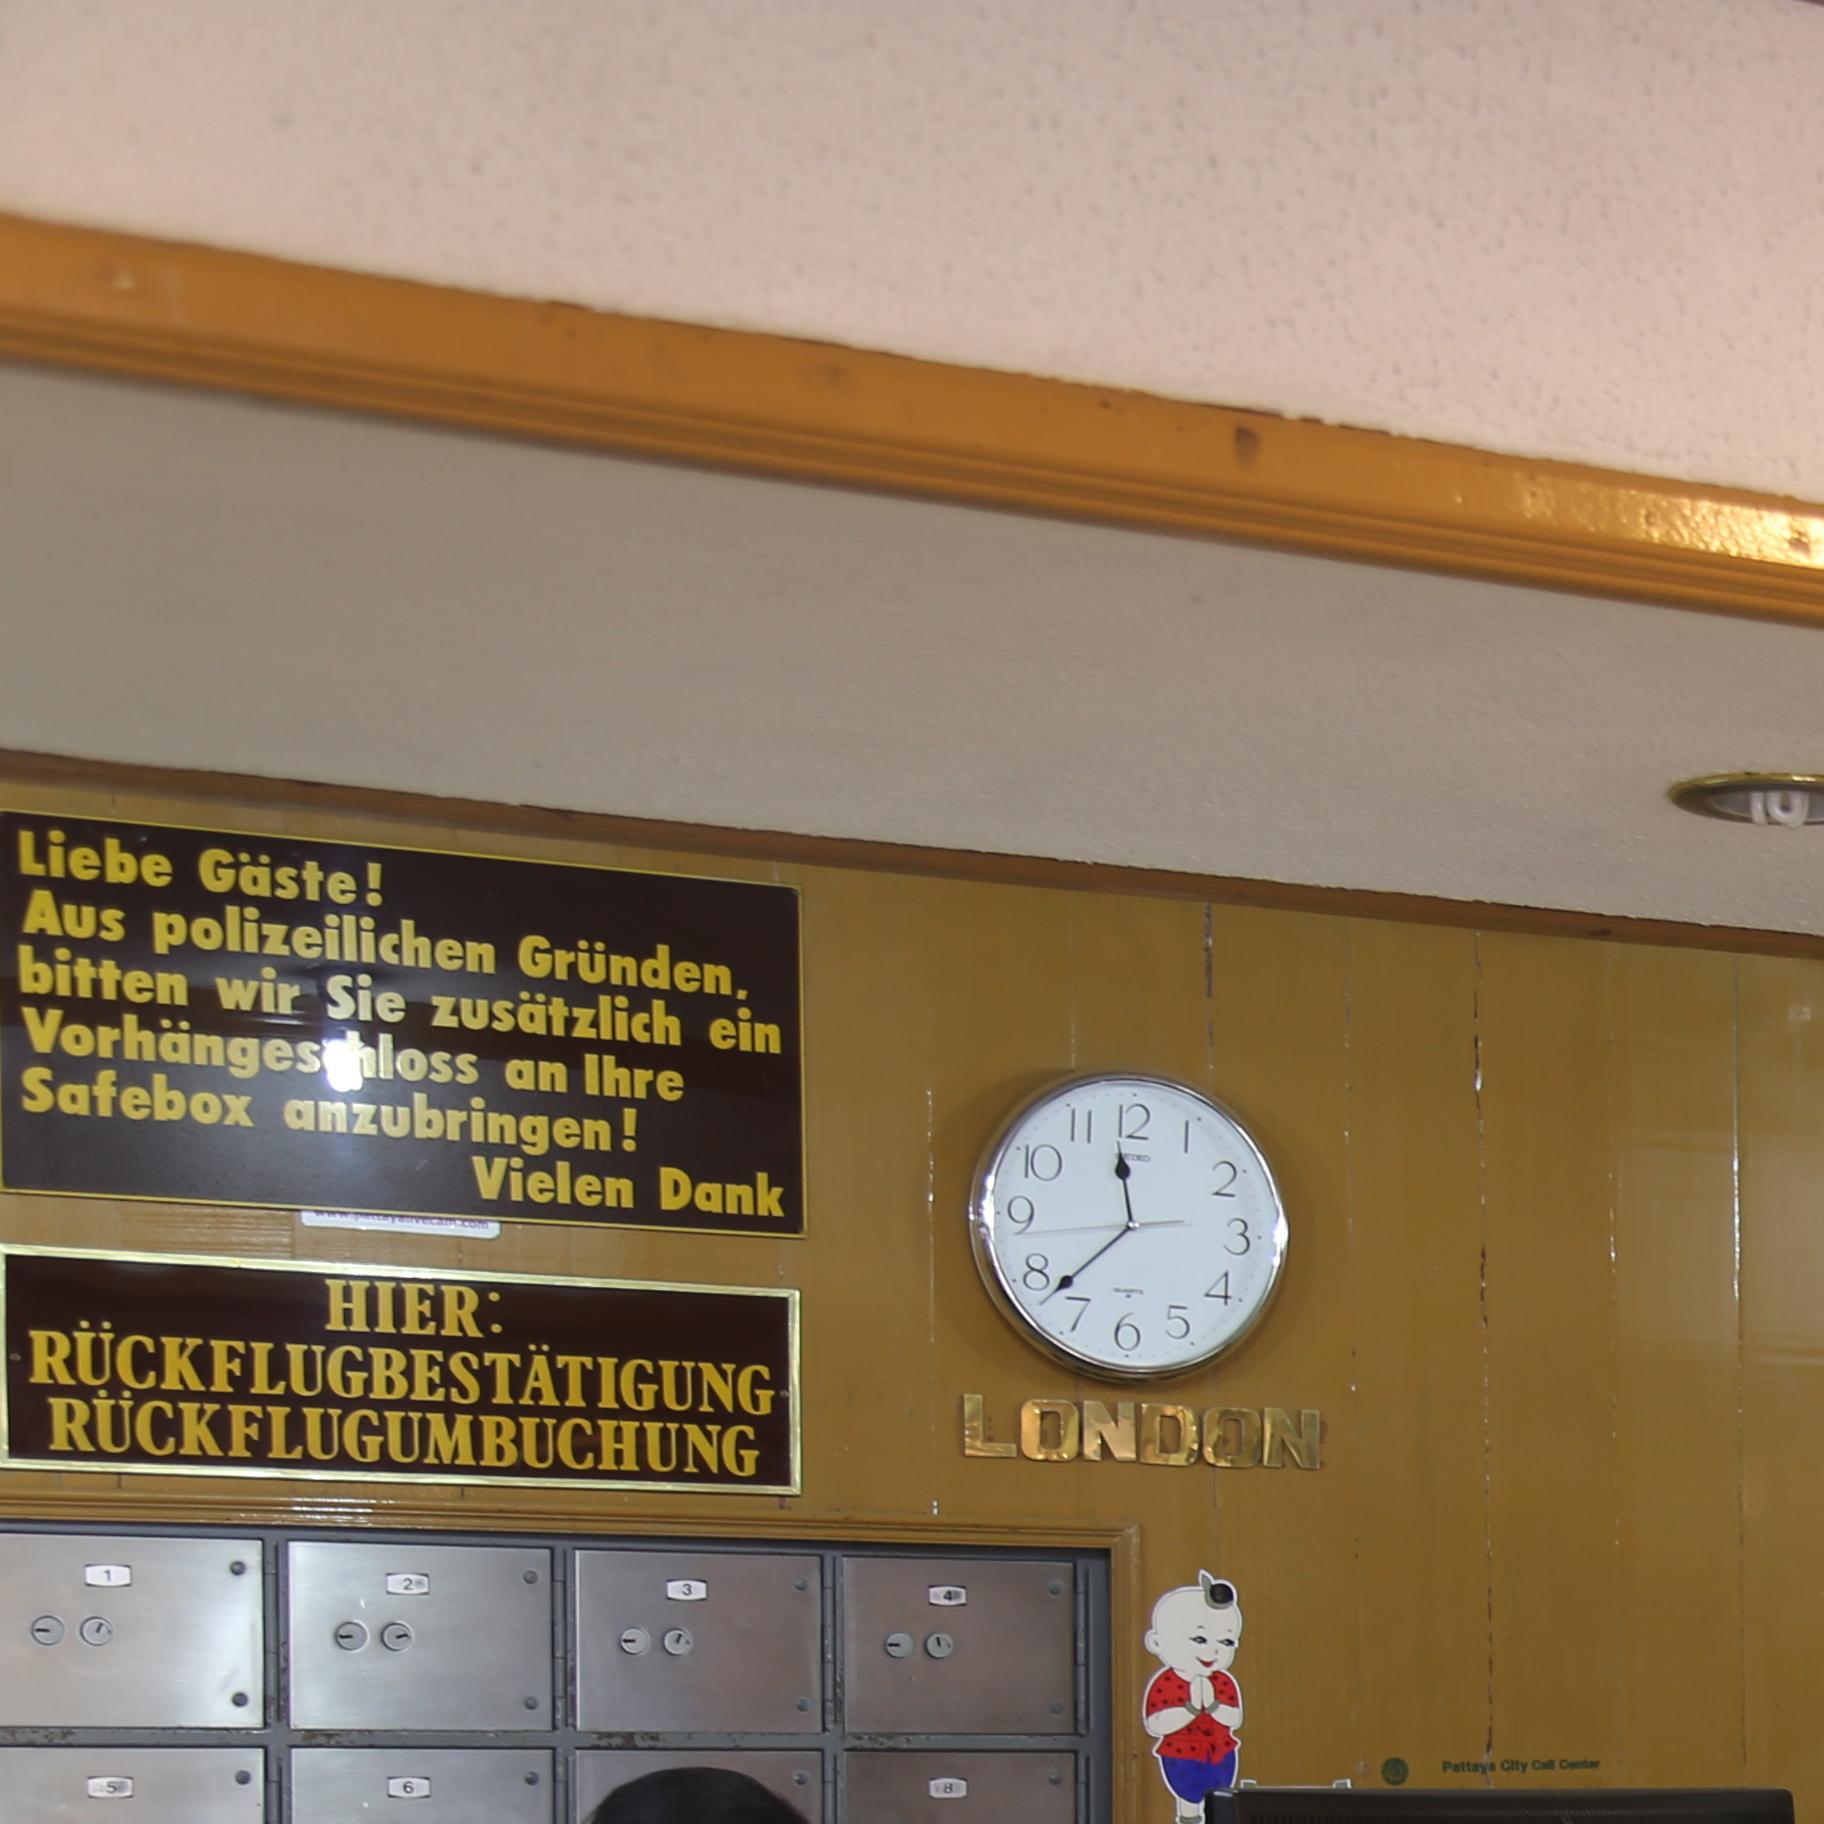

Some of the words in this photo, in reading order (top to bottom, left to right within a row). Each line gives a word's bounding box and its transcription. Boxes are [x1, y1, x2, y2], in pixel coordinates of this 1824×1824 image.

[18, 829, 173, 888] Liebe
[200, 848, 384, 907] Gäste!
[23, 890, 125, 940] Aus
[153, 907, 496, 974] polizeilichen
[518, 936, 750, 997] Gründen,
[19, 946, 188, 1005] bitten
[215, 967, 301, 1015] wir
[326, 975, 406, 1023] Sie
[430, 992, 682, 1046] zusätzlich
[709, 1011, 782, 1054] ein
[21, 1006, 480, 1085] Vorhängeshloss
[506, 1050, 567, 1094] an
[585, 1053, 684, 1101] Ihre
[21, 1067, 253, 1127] Safebox
[285, 1093, 638, 1155] anzubringen!
[1071, 1108, 1092, 1143] 11
[1119, 1104, 1151, 1140] 12
[1024, 1144, 1062, 1181] 10
[1211, 1161, 1237, 1197] 2
[473, 1155, 633, 1208] Vielen
[660, 1168, 785, 1217] Dank
[1007, 1196, 1035, 1234] 9
[1223, 1217, 1250, 1256] 3
[1023, 1253, 1050, 1291] 8
[1204, 1270, 1232, 1305] 4
[326, 1279, 503, 1337] HIER:
[1065, 1296, 1091, 1333] 7
[1165, 1305, 1190, 1339] 5
[1114, 1313, 1141, 1351] 6
[29, 1319, 775, 1416] RÜCKFLUGBESTÄTIGUNG
[49, 1388, 759, 1478] RÜCKFLUGUMBUCHUNG
[964, 1393, 1321, 1470] LONDON
[104, 1570, 112, 1582] 1
[403, 1578, 413, 1591] 2
[682, 1583, 692, 1596] 3
[943, 1590, 953, 1602] 4
[1442, 1760, 1495, 1774] Pattaya
[1501, 1759, 1527, 1773] City
[1559, 1759, 1600, 1770] Center
[106, 1781, 117, 1794] 5
[403, 1781, 413, 1794] 6
